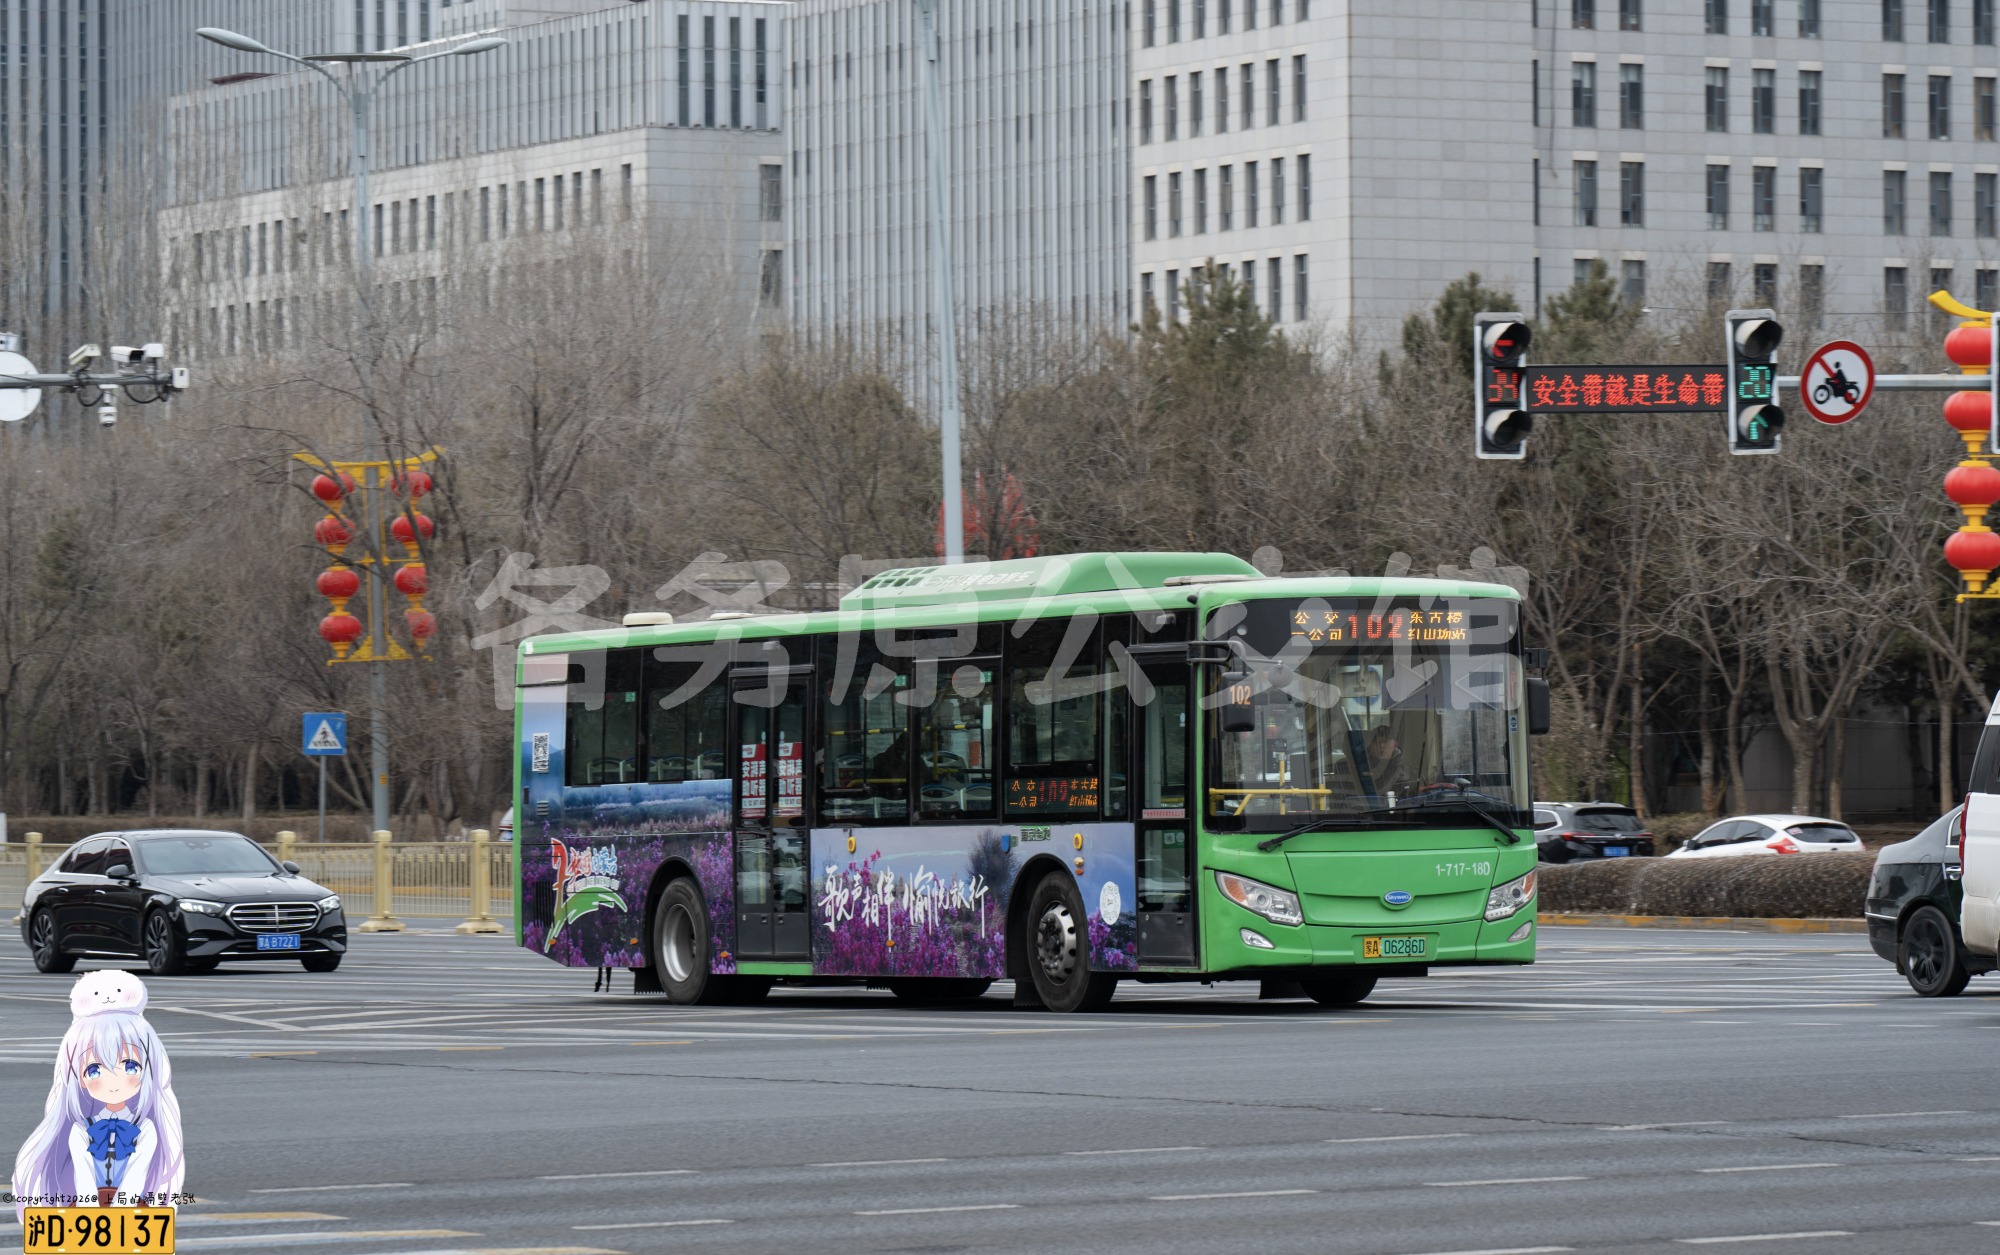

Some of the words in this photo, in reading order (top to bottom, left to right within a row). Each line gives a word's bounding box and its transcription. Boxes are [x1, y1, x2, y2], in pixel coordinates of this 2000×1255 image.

[1531, 374, 1725, 407] 安全带就是生命带
[1738, 365, 1770, 398] 20
[1348, 614, 1403, 639] 102
[1230, 685, 1251, 706] 102
[1435, 861, 1491, 877] 1-717-18D
